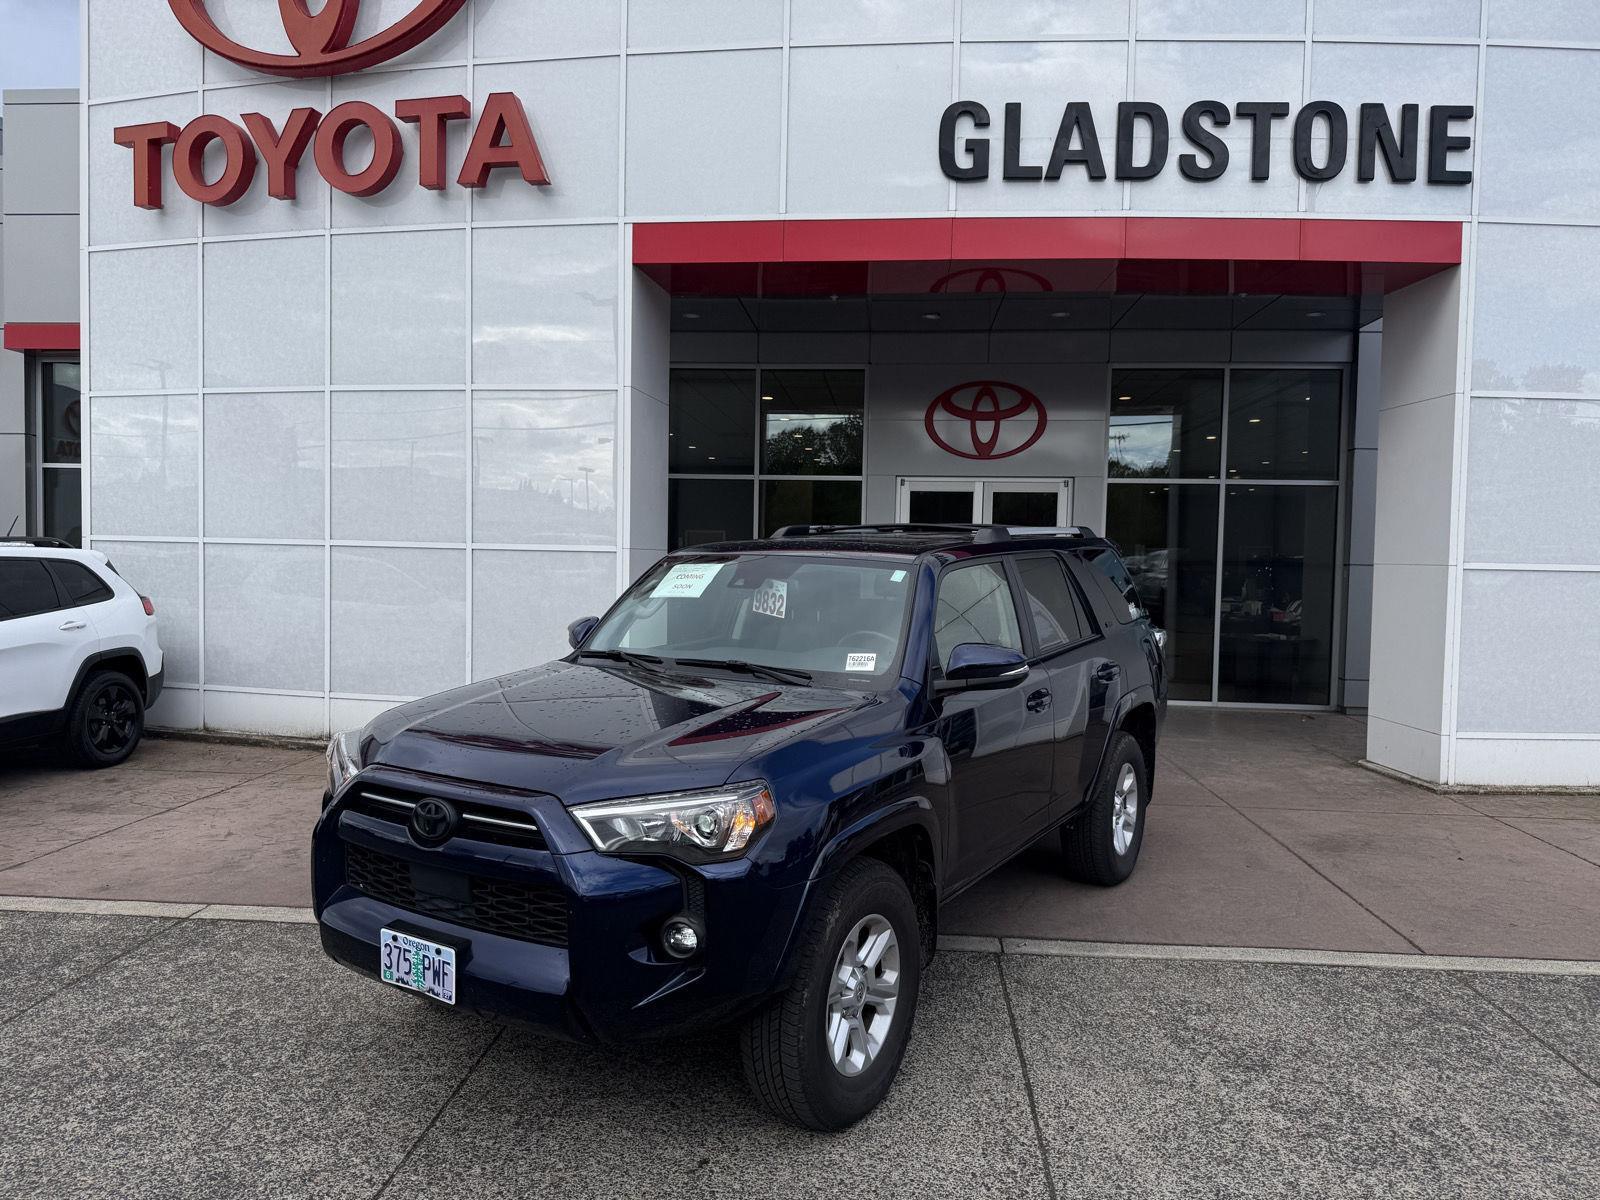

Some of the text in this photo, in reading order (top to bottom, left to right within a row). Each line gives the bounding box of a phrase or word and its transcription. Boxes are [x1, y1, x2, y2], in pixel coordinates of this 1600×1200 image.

[113, 92, 551, 210] TOYOTA
[938, 100, 1475, 185] GLADSTONE
[754, 589, 785, 617] 9832
[383, 942, 451, 988] 375 PWF
[402, 936, 430, 953] Oregon
